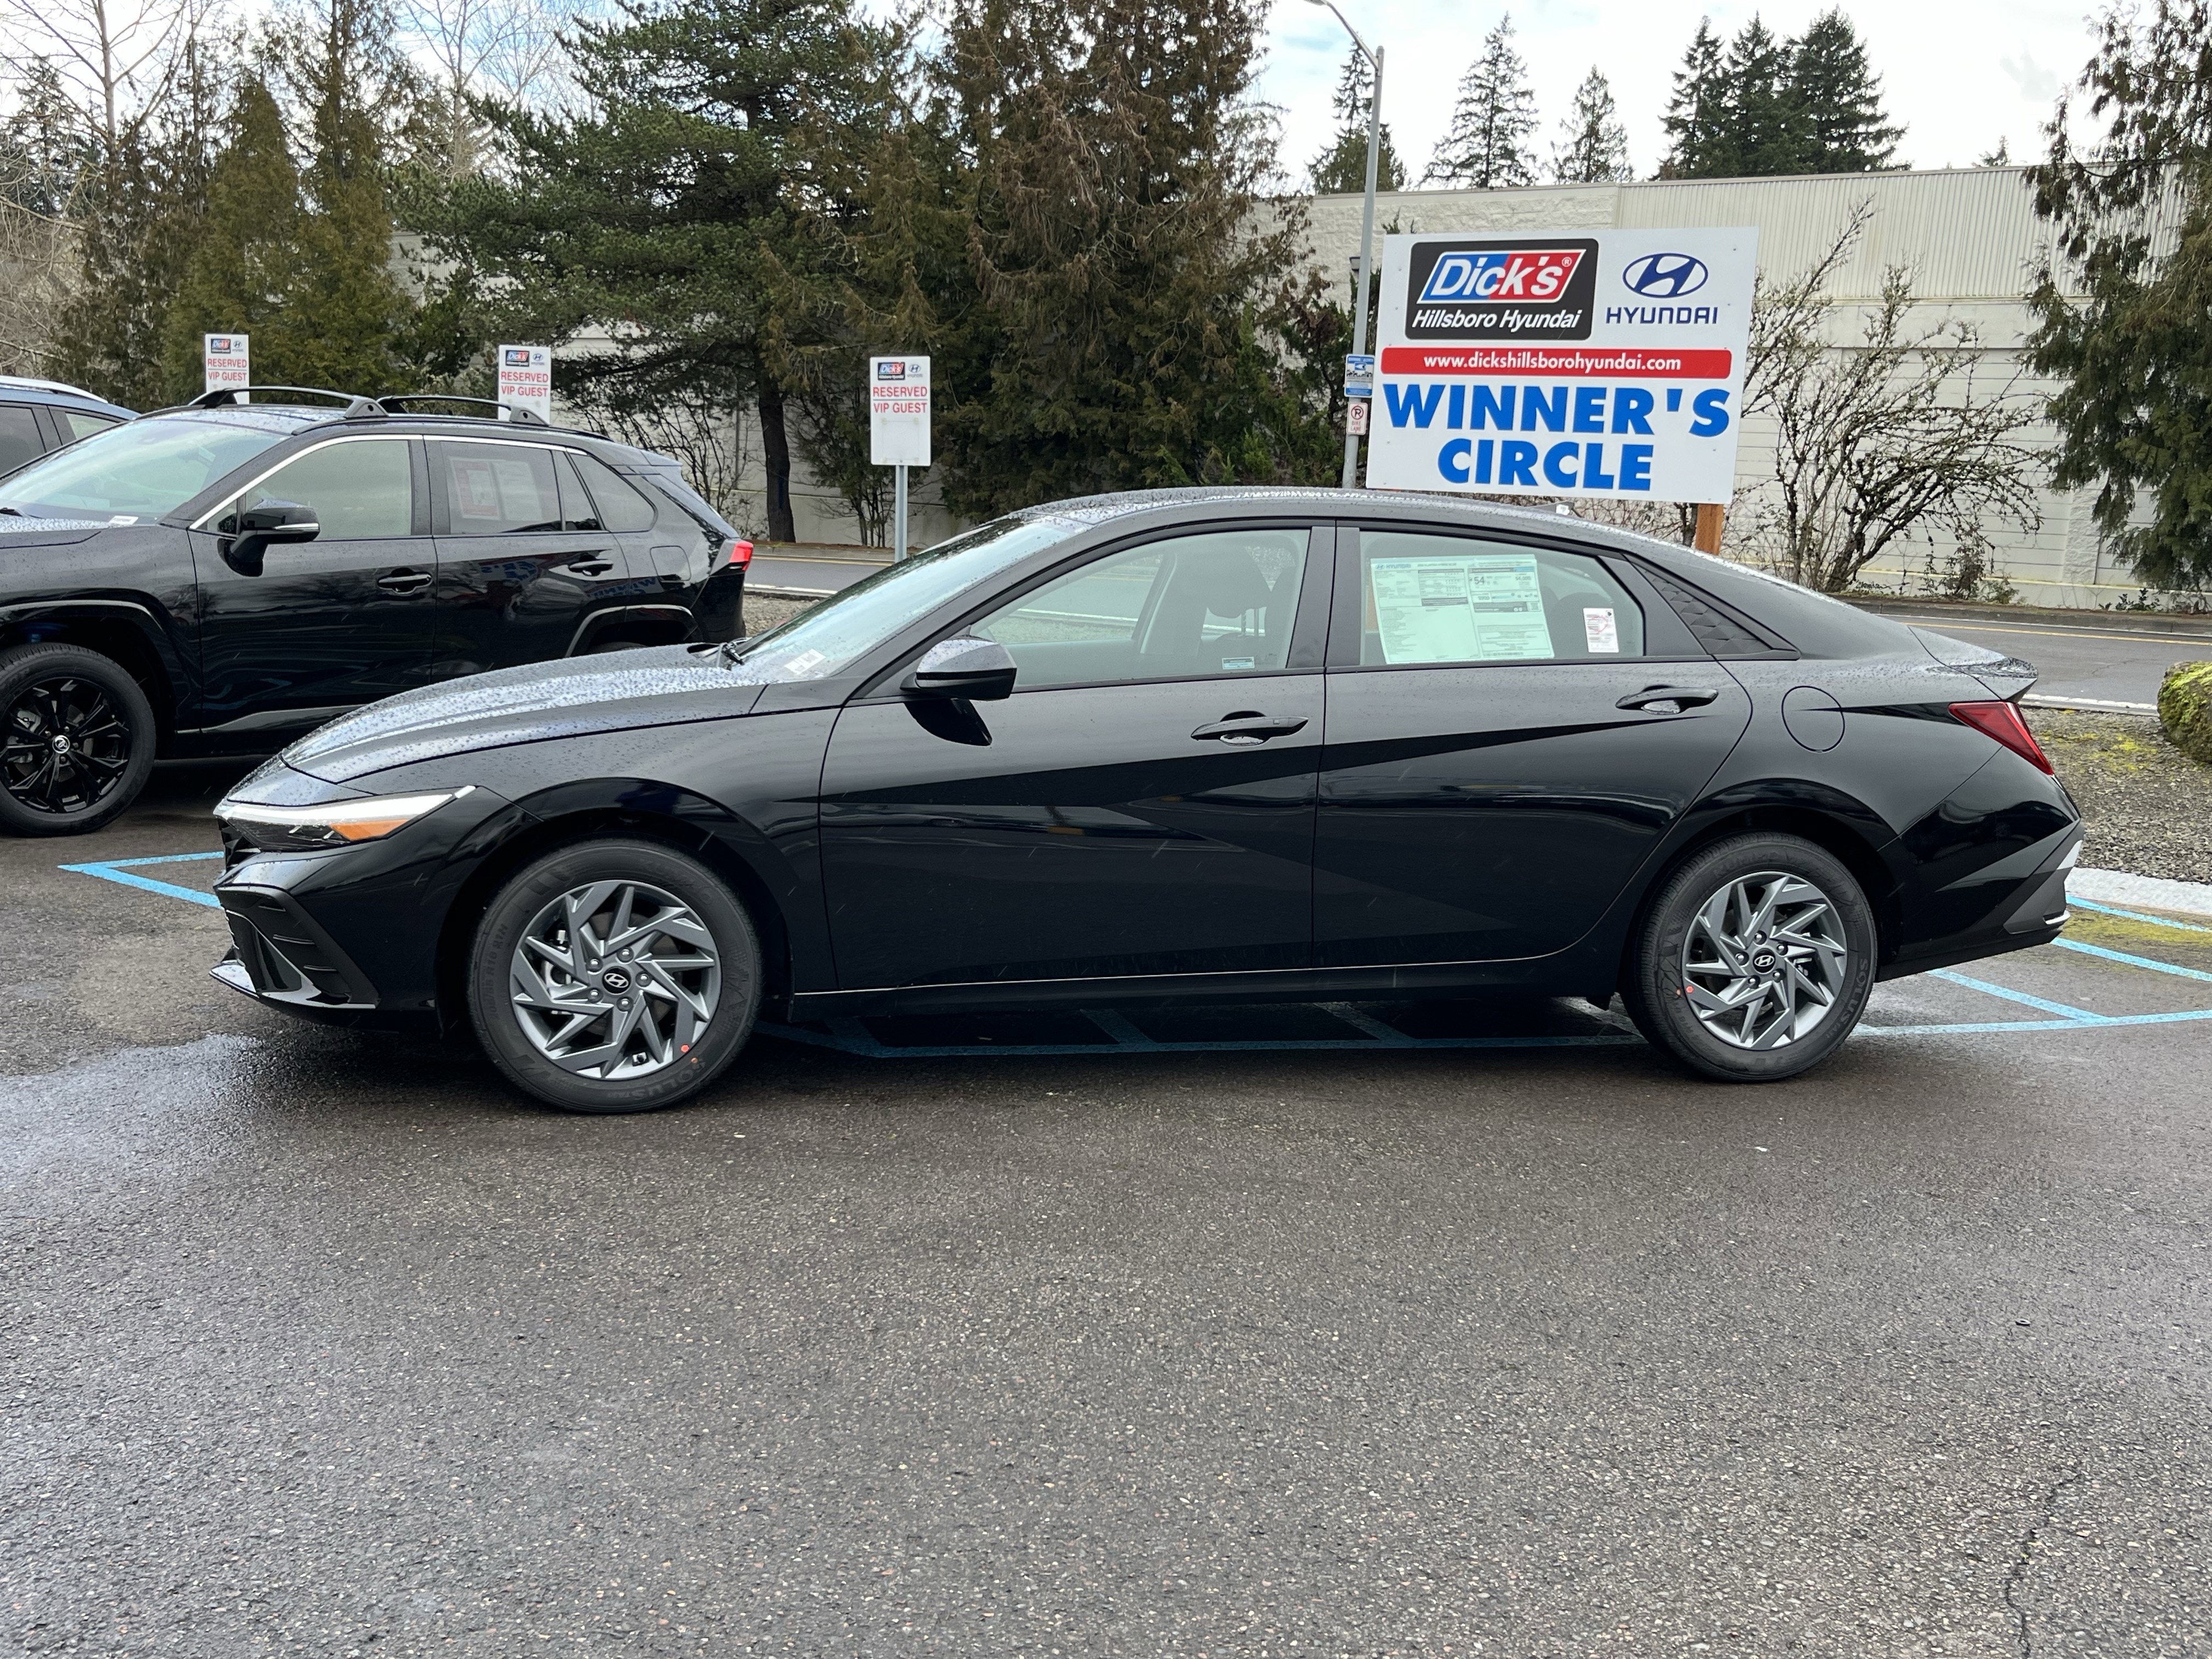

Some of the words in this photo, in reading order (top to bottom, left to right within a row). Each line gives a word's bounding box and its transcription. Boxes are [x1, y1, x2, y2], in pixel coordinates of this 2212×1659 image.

[1412, 309, 1498, 328] Hillsboro
[1499, 309, 1583, 333] Hyundai
[1606, 307, 1718, 324] HYUNDAI
[207, 358, 247, 368] RESERVED
[1423, 351, 1681, 374] www.dickshillsborohyundai.com
[208, 371, 220, 380] VIP
[222, 372, 246, 381] GUEST
[501, 371, 549, 382] RESERVED
[501, 386, 515, 395] VIP
[518, 386, 548, 397] GUEST
[873, 386, 928, 397] RESERVED
[873, 403, 889, 413] VIP
[892, 403, 928, 413] GUEST
[1383, 383, 1731, 438] WINNER'S
[1437, 438, 1654, 492] CIRCLE
